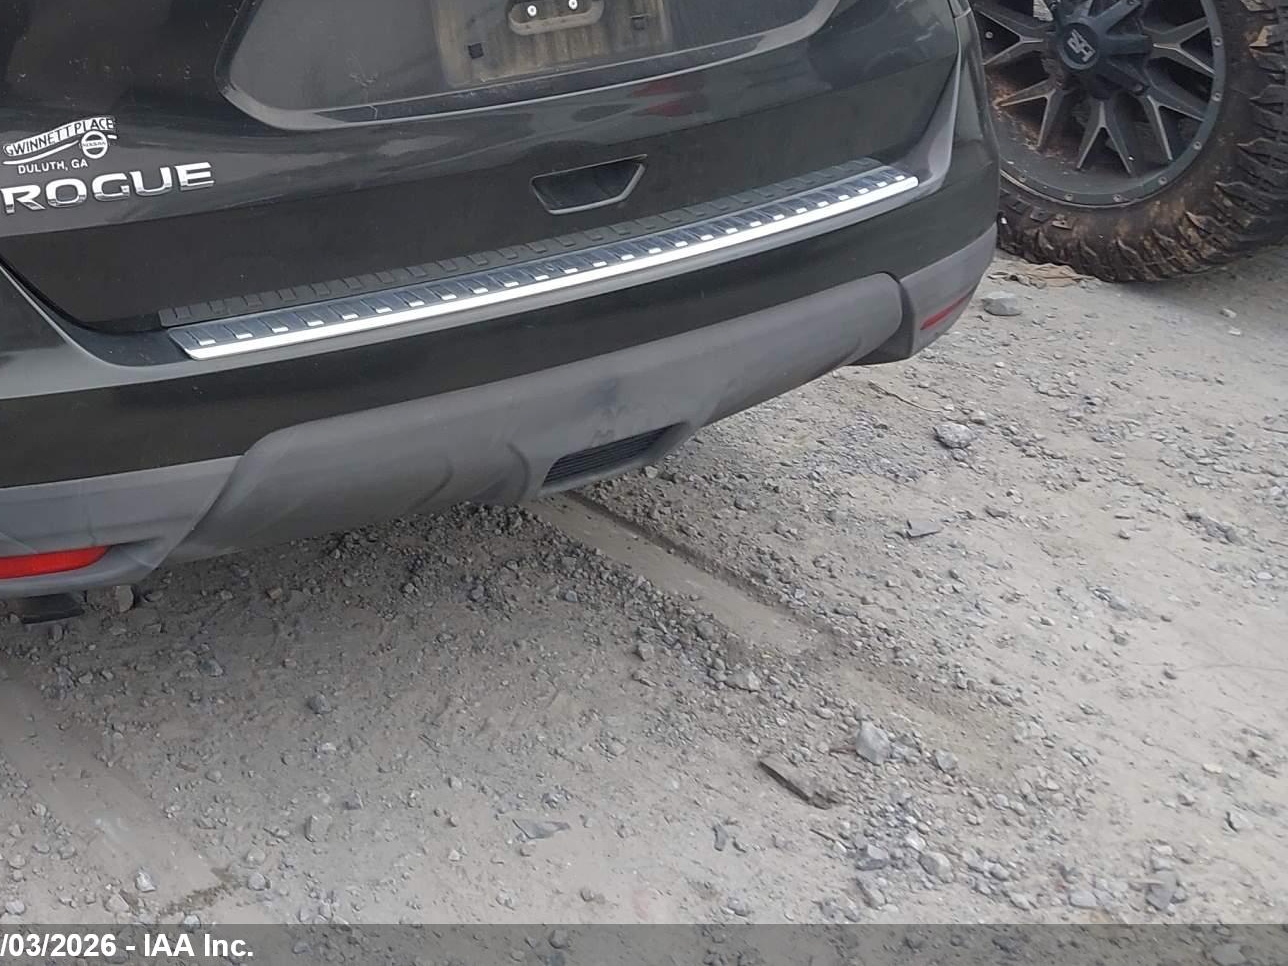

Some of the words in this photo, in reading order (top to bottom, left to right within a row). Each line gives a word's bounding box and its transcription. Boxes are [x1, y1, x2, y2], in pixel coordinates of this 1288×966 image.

[4, 124, 73, 155] GWINNETT
[74, 118, 115, 134] PLACE
[18, 161, 69, 174] DULUTH,
[71, 159, 88, 169] GA
[0, 162, 214, 213] ROGUE
